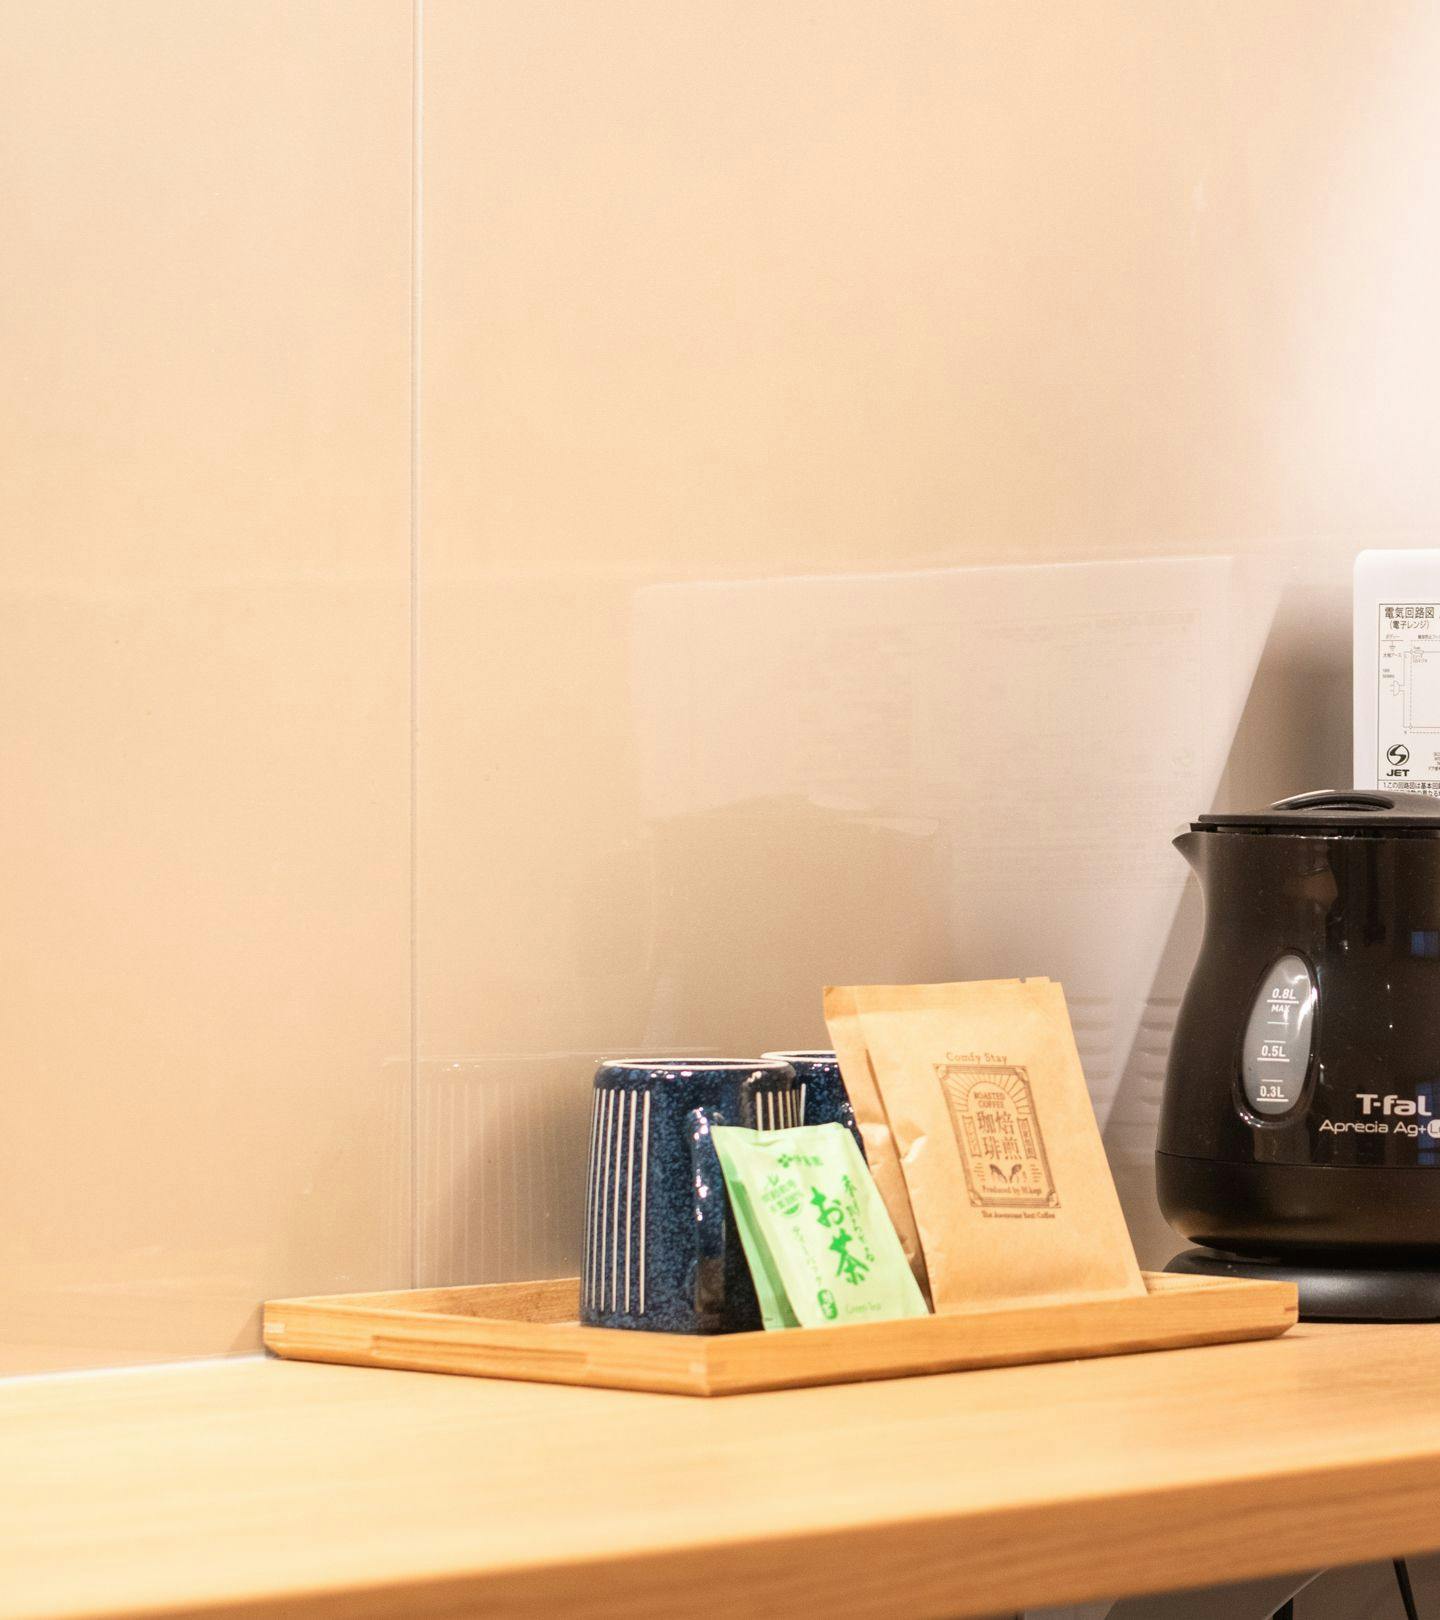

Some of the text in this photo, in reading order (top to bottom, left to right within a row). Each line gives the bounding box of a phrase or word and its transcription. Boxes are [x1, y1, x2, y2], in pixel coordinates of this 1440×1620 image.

[1385, 606, 1434, 619] 電気回路図
[1272, 988, 1296, 1000] 0.8L
[1271, 1004, 1290, 1013] MAX
[1261, 1045, 1286, 1057] 0.5L
[946, 1052, 1008, 1065] Comfy Stay
[1260, 1086, 1285, 1098] 0.3L
[1356, 1093, 1432, 1116] T-fal
[1319, 1119, 1389, 1134] Aprecia
